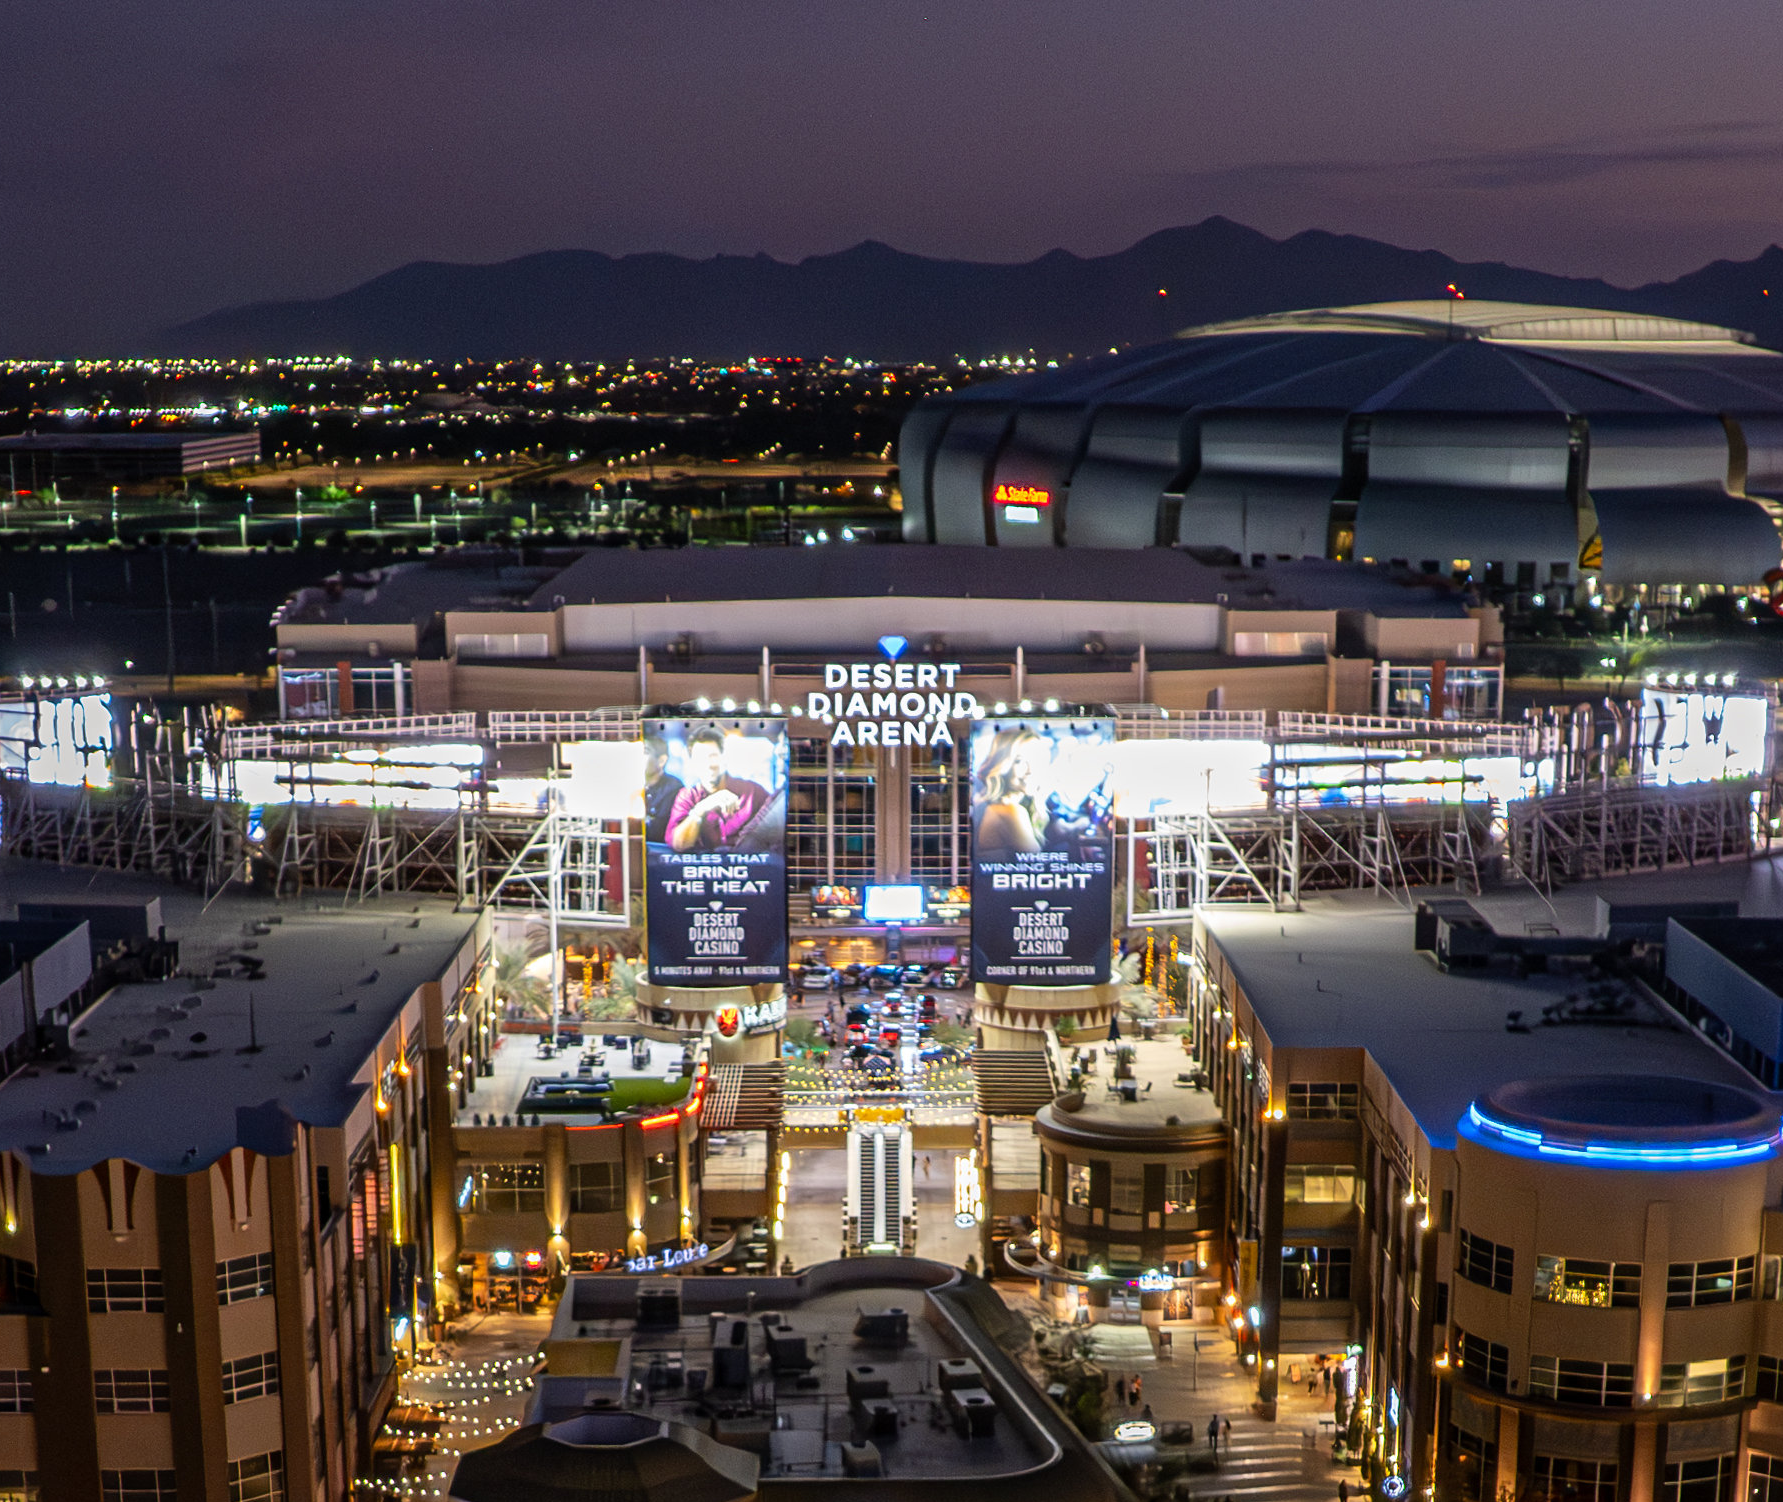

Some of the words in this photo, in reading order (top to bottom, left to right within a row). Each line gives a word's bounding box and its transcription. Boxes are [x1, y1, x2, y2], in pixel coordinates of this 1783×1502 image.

[825, 664, 961, 688] DESERT
[808, 692, 977, 717] DIAMOND
[831, 721, 954, 745] ARENA
[662, 854, 722, 863] TABLES
[728, 854, 770, 863] THAT
[1015, 852, 1069, 862] WHERE
[683, 866, 749, 878] BRING
[980, 863, 1045, 872] WINNING
[1050, 863, 1105, 872] SHINES
[662, 881, 705, 893] THE
[713, 881, 770, 893] HEAT
[993, 874, 1092, 889] BRIGHT
[694, 913, 740, 927] DESERT
[1019, 913, 1065, 926] DESERT
[689, 927, 745, 941] DIAMOND
[1013, 927, 1069, 940] DIAMOND
[694, 941, 740, 955] CASINO
[1018, 941, 1064, 954] CASINO
[661, 966, 692, 975] MINUTES
[693, 966, 712, 975] AWAY
[743, 966, 780, 975] NORTHERN
[986, 966, 1017, 975] CORNER
[1018, 966, 1028, 975] OF
[1055, 966, 1096, 975] NORTHERN
